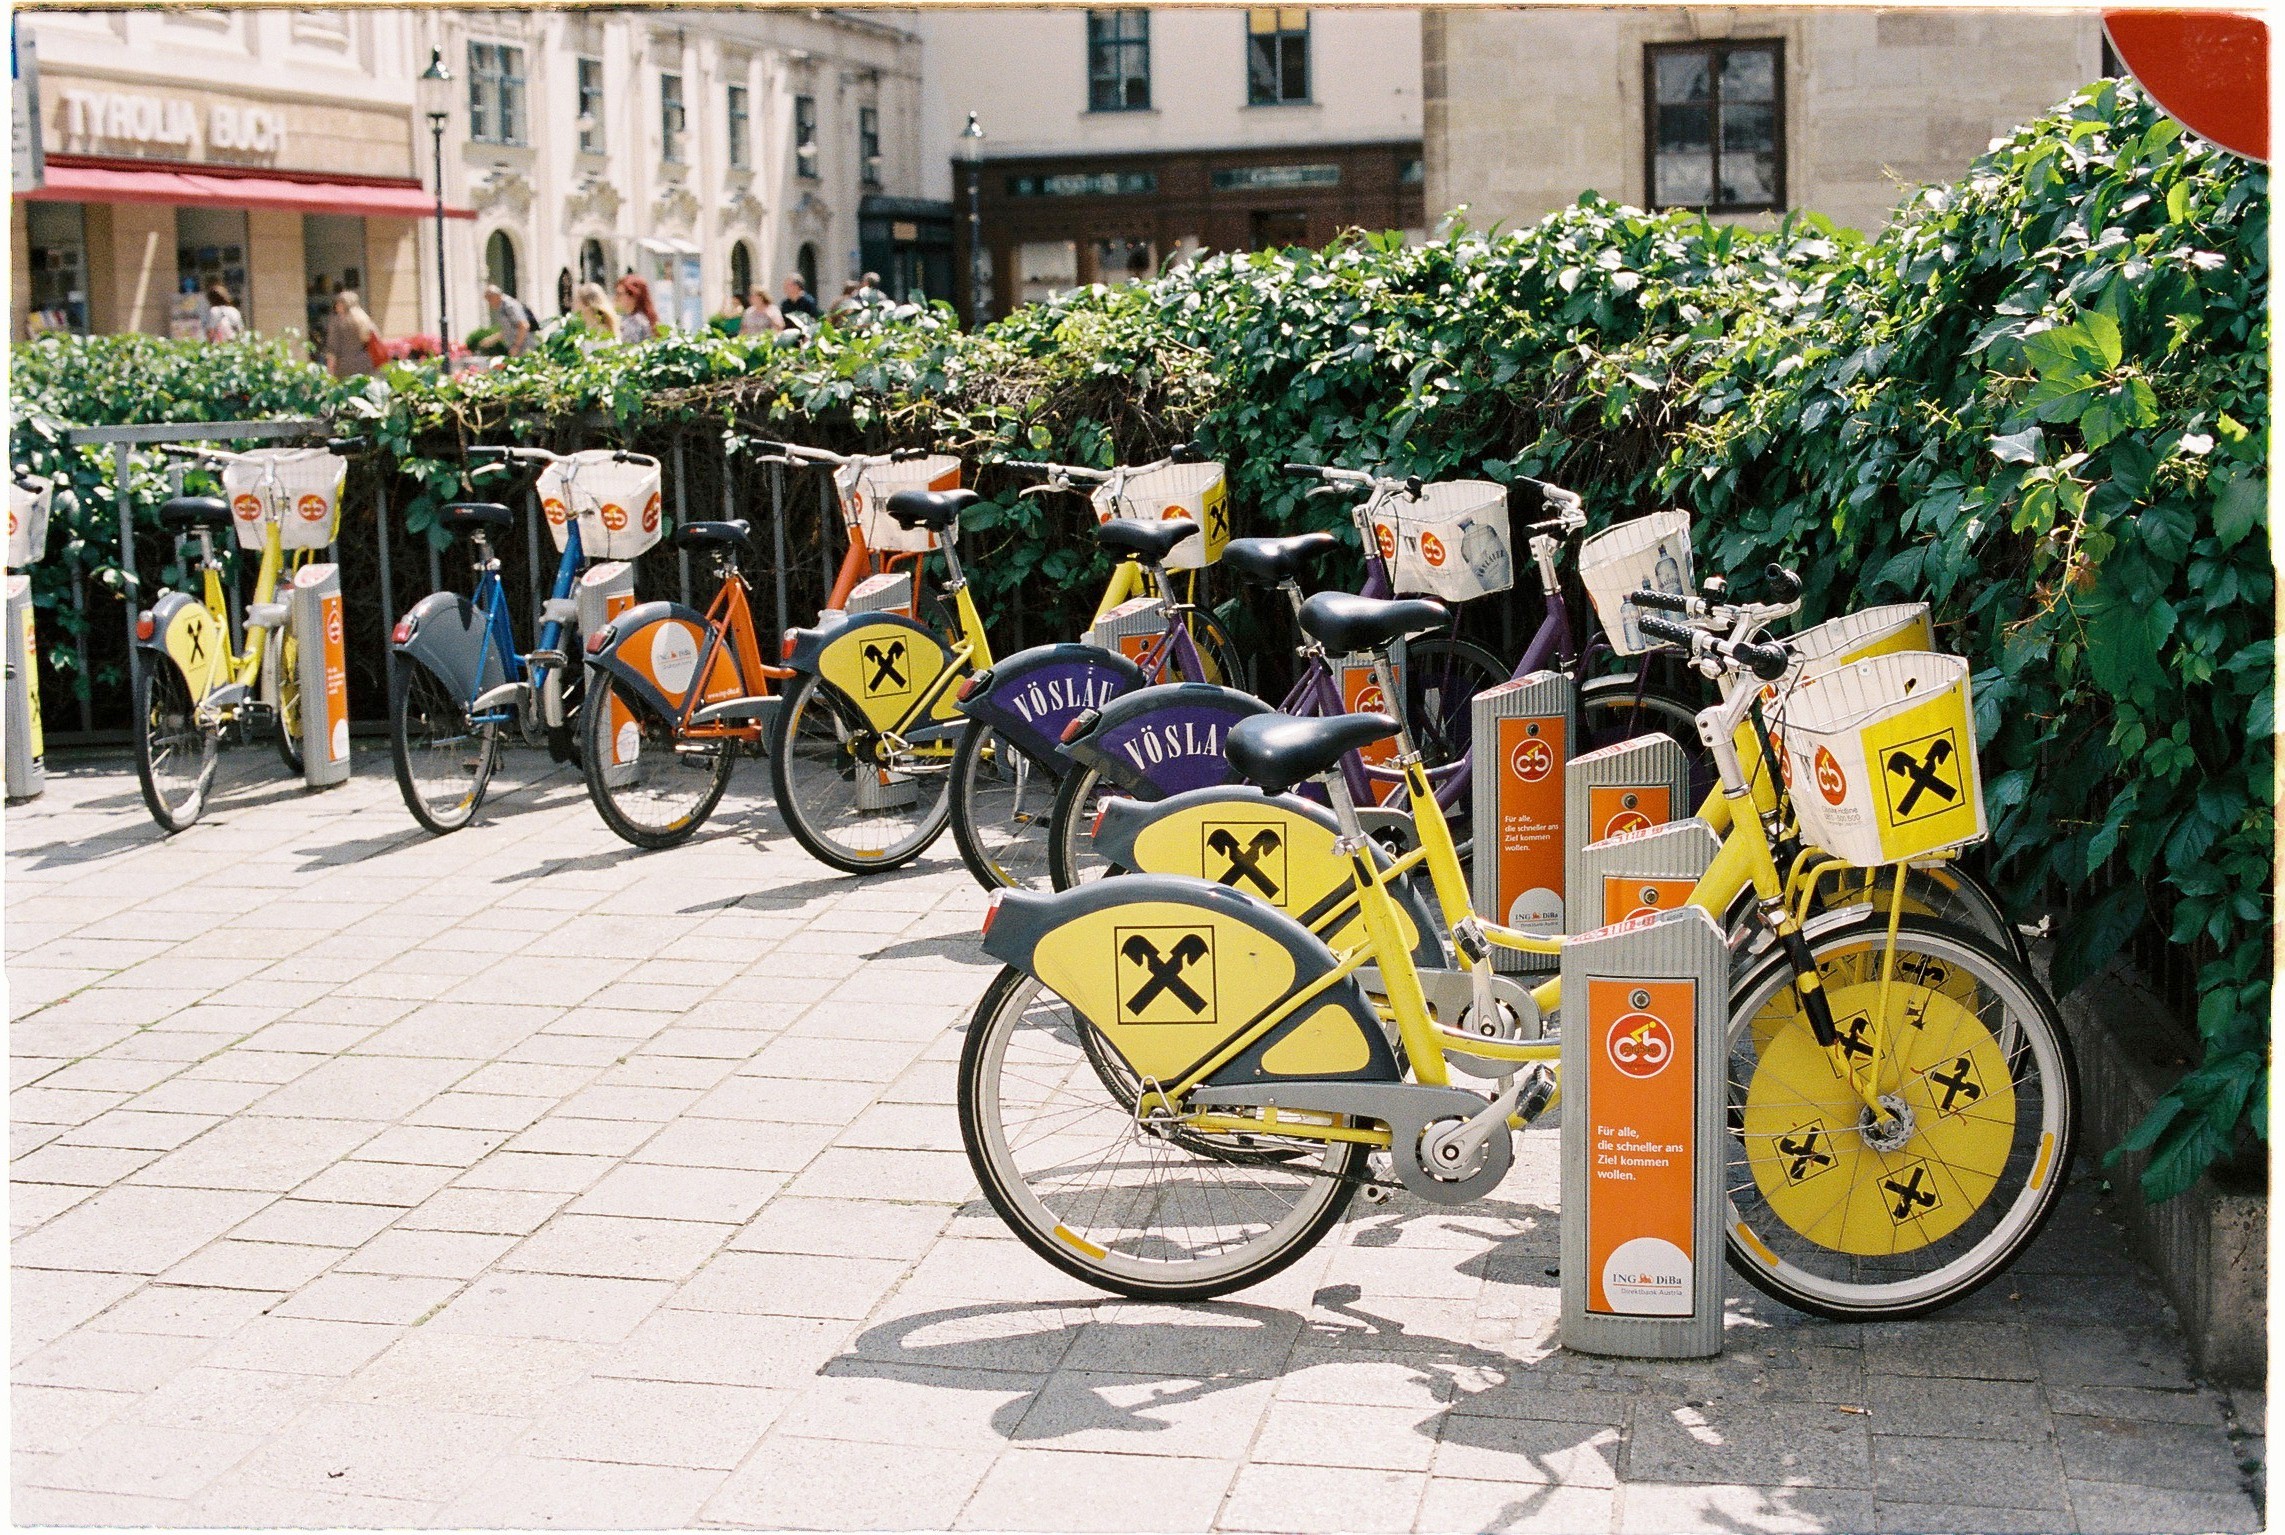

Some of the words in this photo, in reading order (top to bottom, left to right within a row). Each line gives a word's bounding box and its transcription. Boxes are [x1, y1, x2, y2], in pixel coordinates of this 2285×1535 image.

[64, 88, 198, 145] TYROLIA
[210, 104, 286, 152] BUCH
[1123, 722, 1232, 770] VÖSLA
[1504, 815, 1517, 823] Für
[1518, 814, 1533, 823] alle,
[1504, 824, 1516, 832] die
[1517, 823, 1547, 832] schneller
[1504, 834, 1519, 842] Ziel
[1597, 1125, 1615, 1136] Für
[1617, 1126, 1640, 1139] alle,
[1597, 1139, 1614, 1150] die
[1616, 1141, 1663, 1153] schneller
[1665, 1144, 1684, 1153] ans
[1597, 1154, 1617, 1165] Ziel
[1620, 1155, 1669, 1167] kommen
[1597, 1169, 1636, 1181] wollen.
[1613, 1273, 1637, 1283] ING
[1656, 1275, 1682, 1285] DiBa
[1621, 1287, 1657, 1296] Direktbank
